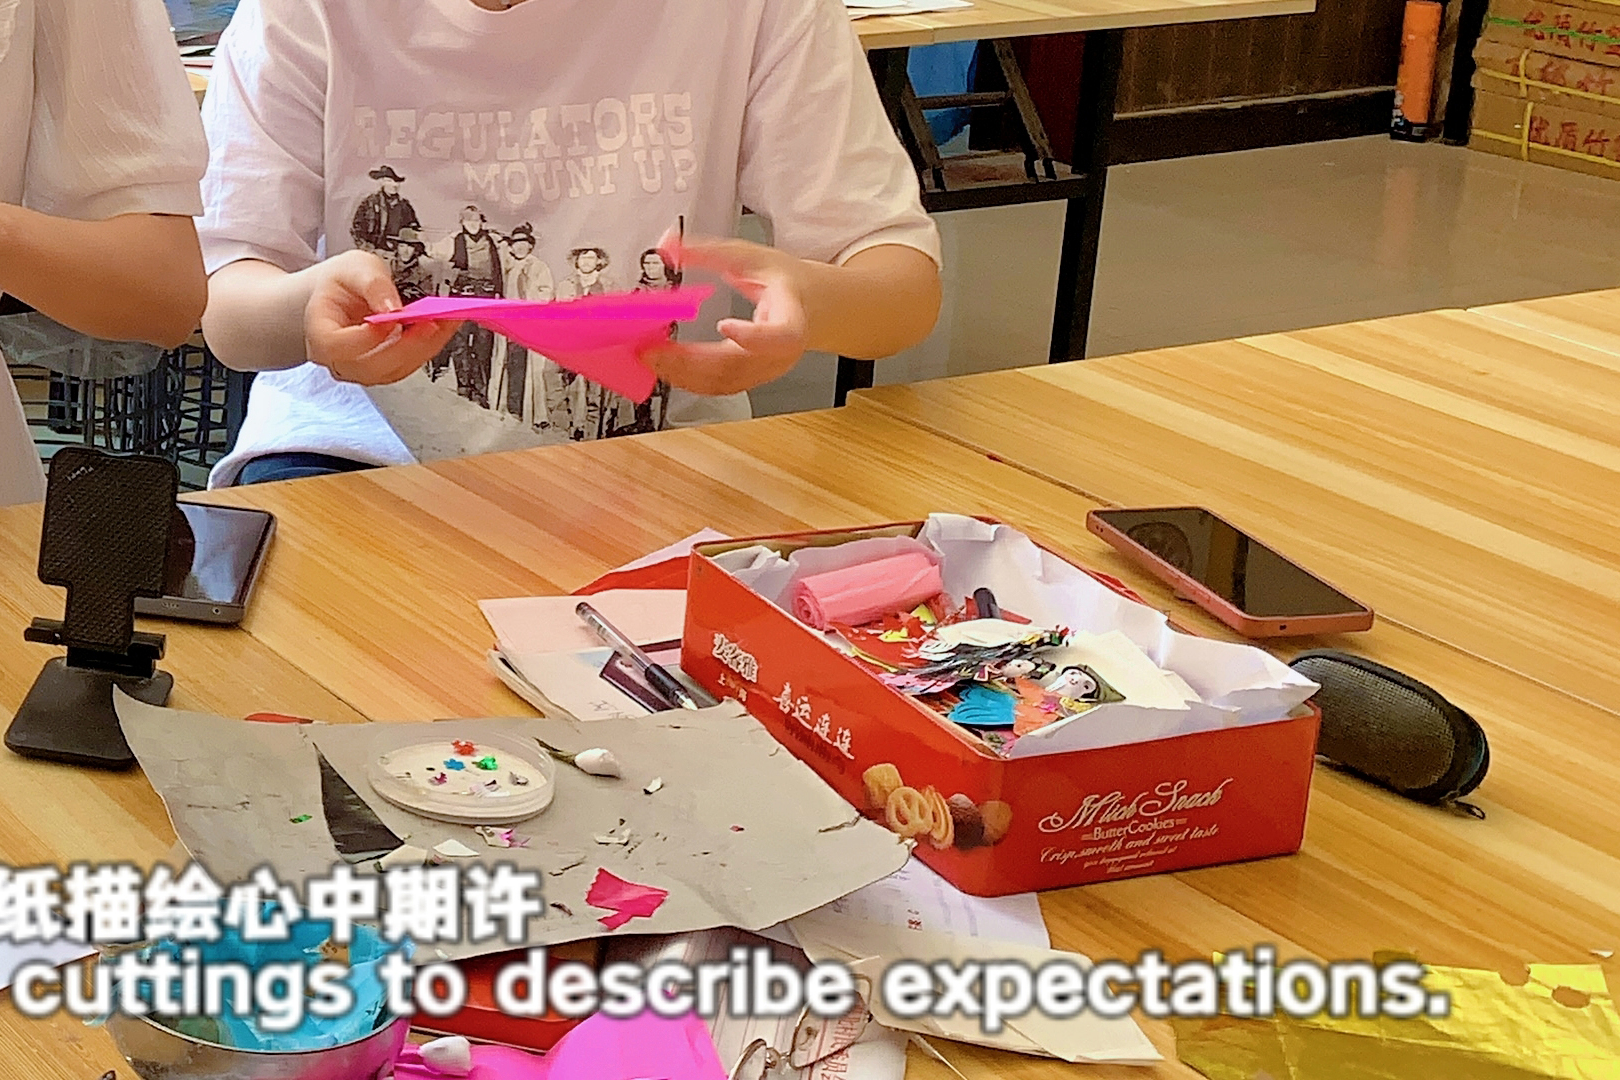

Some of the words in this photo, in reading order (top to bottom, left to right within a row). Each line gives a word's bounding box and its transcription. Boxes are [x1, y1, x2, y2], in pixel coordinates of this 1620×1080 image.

[354, 92, 694, 160] REGULATORS
[463, 153, 619, 204] MOUNT
[633, 149, 696, 193] UP
[772, 682, 855, 760] 喜运连连
